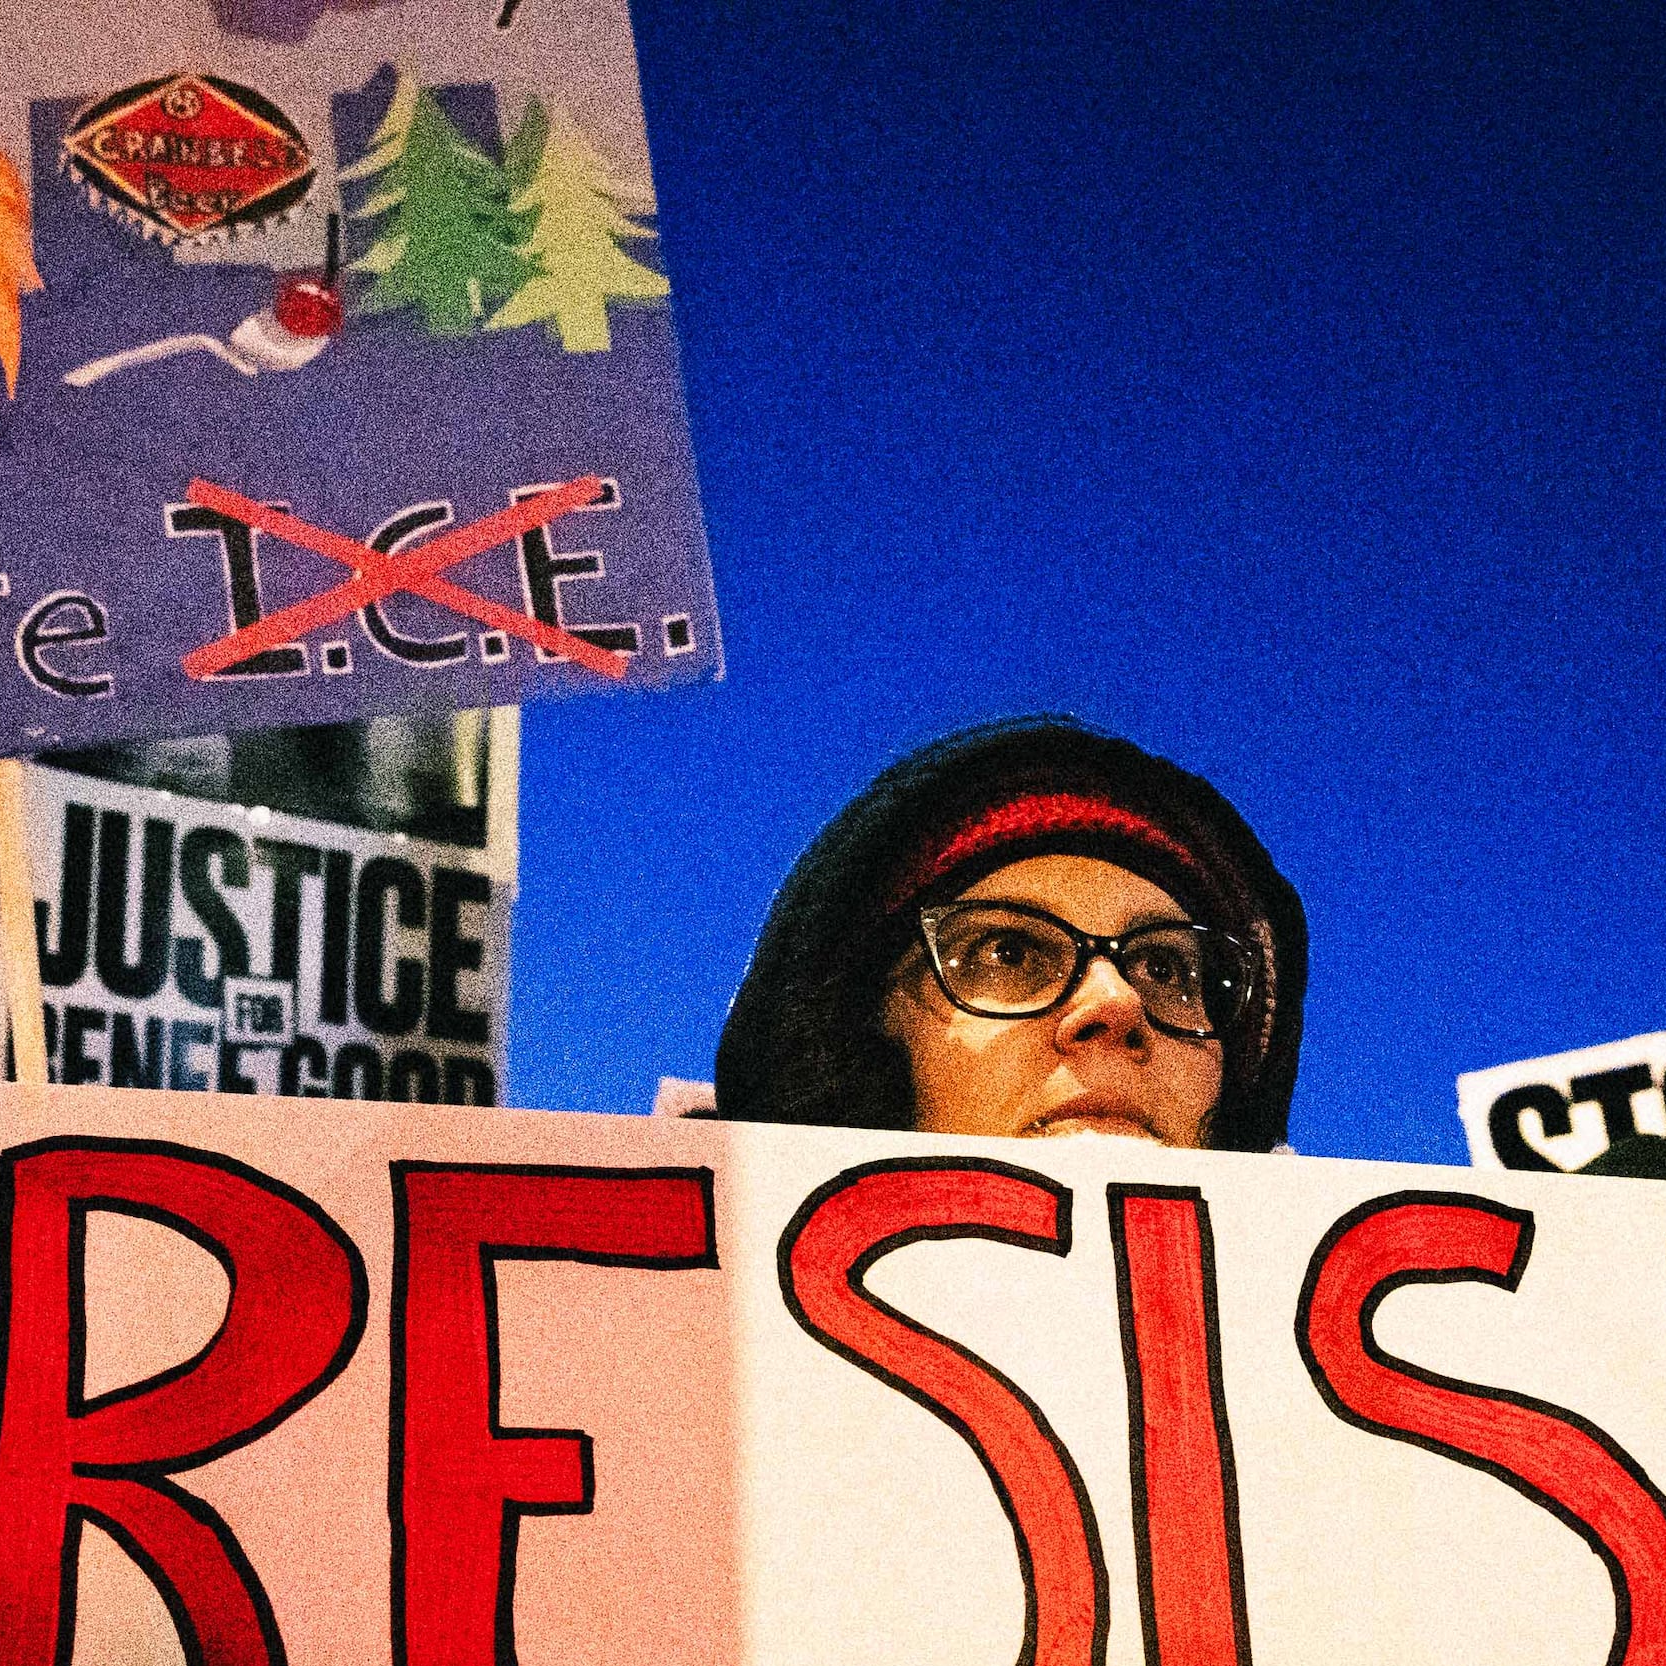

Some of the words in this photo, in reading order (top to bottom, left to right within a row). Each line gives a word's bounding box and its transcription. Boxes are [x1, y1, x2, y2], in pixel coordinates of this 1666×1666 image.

[163, 478, 696, 684] I.C.E.
[33, 803, 493, 1042] JUSTICE
[235, 993, 285, 1034] FOR
